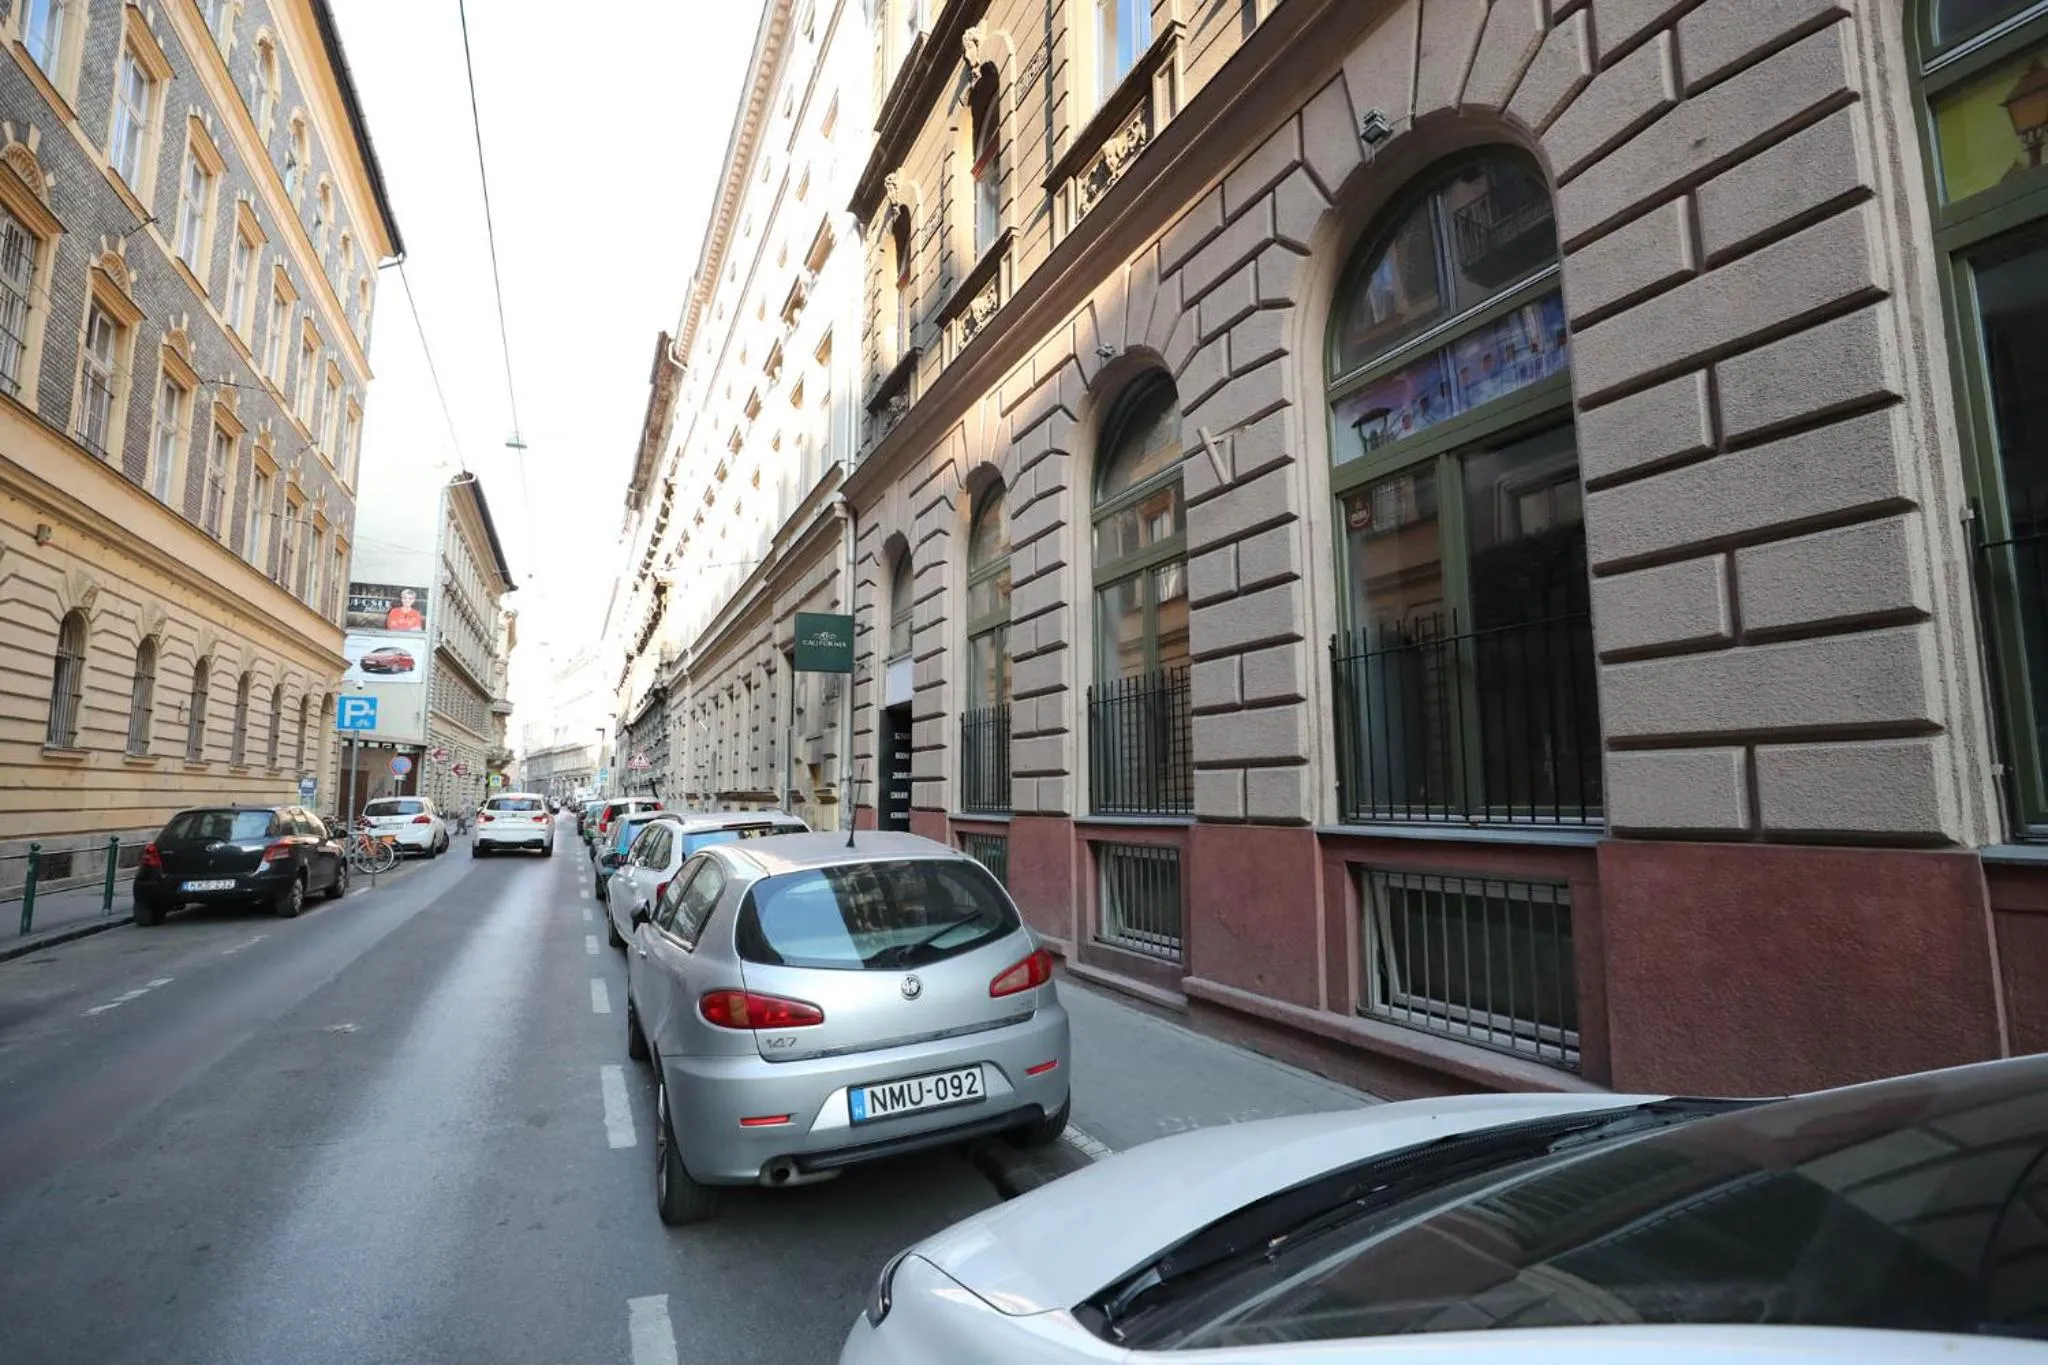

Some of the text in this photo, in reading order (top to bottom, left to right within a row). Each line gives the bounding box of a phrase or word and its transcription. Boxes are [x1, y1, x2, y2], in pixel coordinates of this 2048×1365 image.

[344, 700, 371, 727] P
[766, 1036, 797, 1049] 147
[869, 1071, 979, 1114] NMU-092
